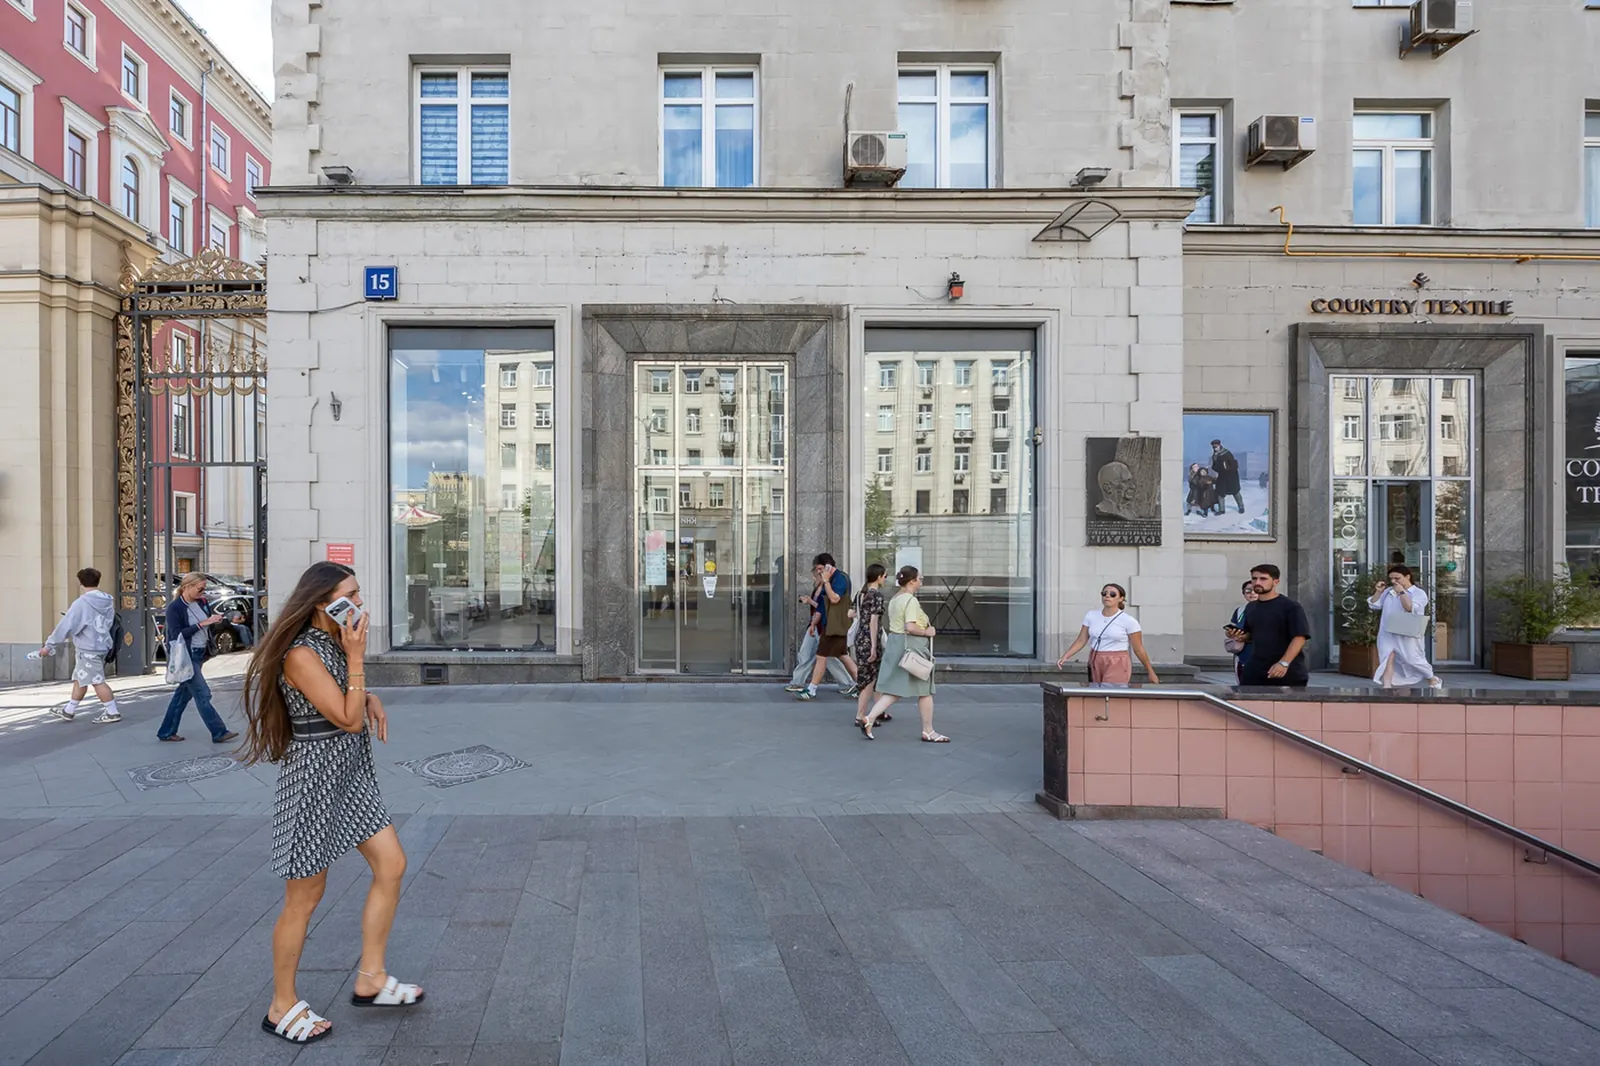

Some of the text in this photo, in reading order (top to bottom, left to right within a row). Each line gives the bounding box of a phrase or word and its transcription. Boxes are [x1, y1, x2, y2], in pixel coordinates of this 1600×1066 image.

[370, 273, 390, 290] 15
[1310, 297, 1514, 316] COUNTRY TEXTILE
